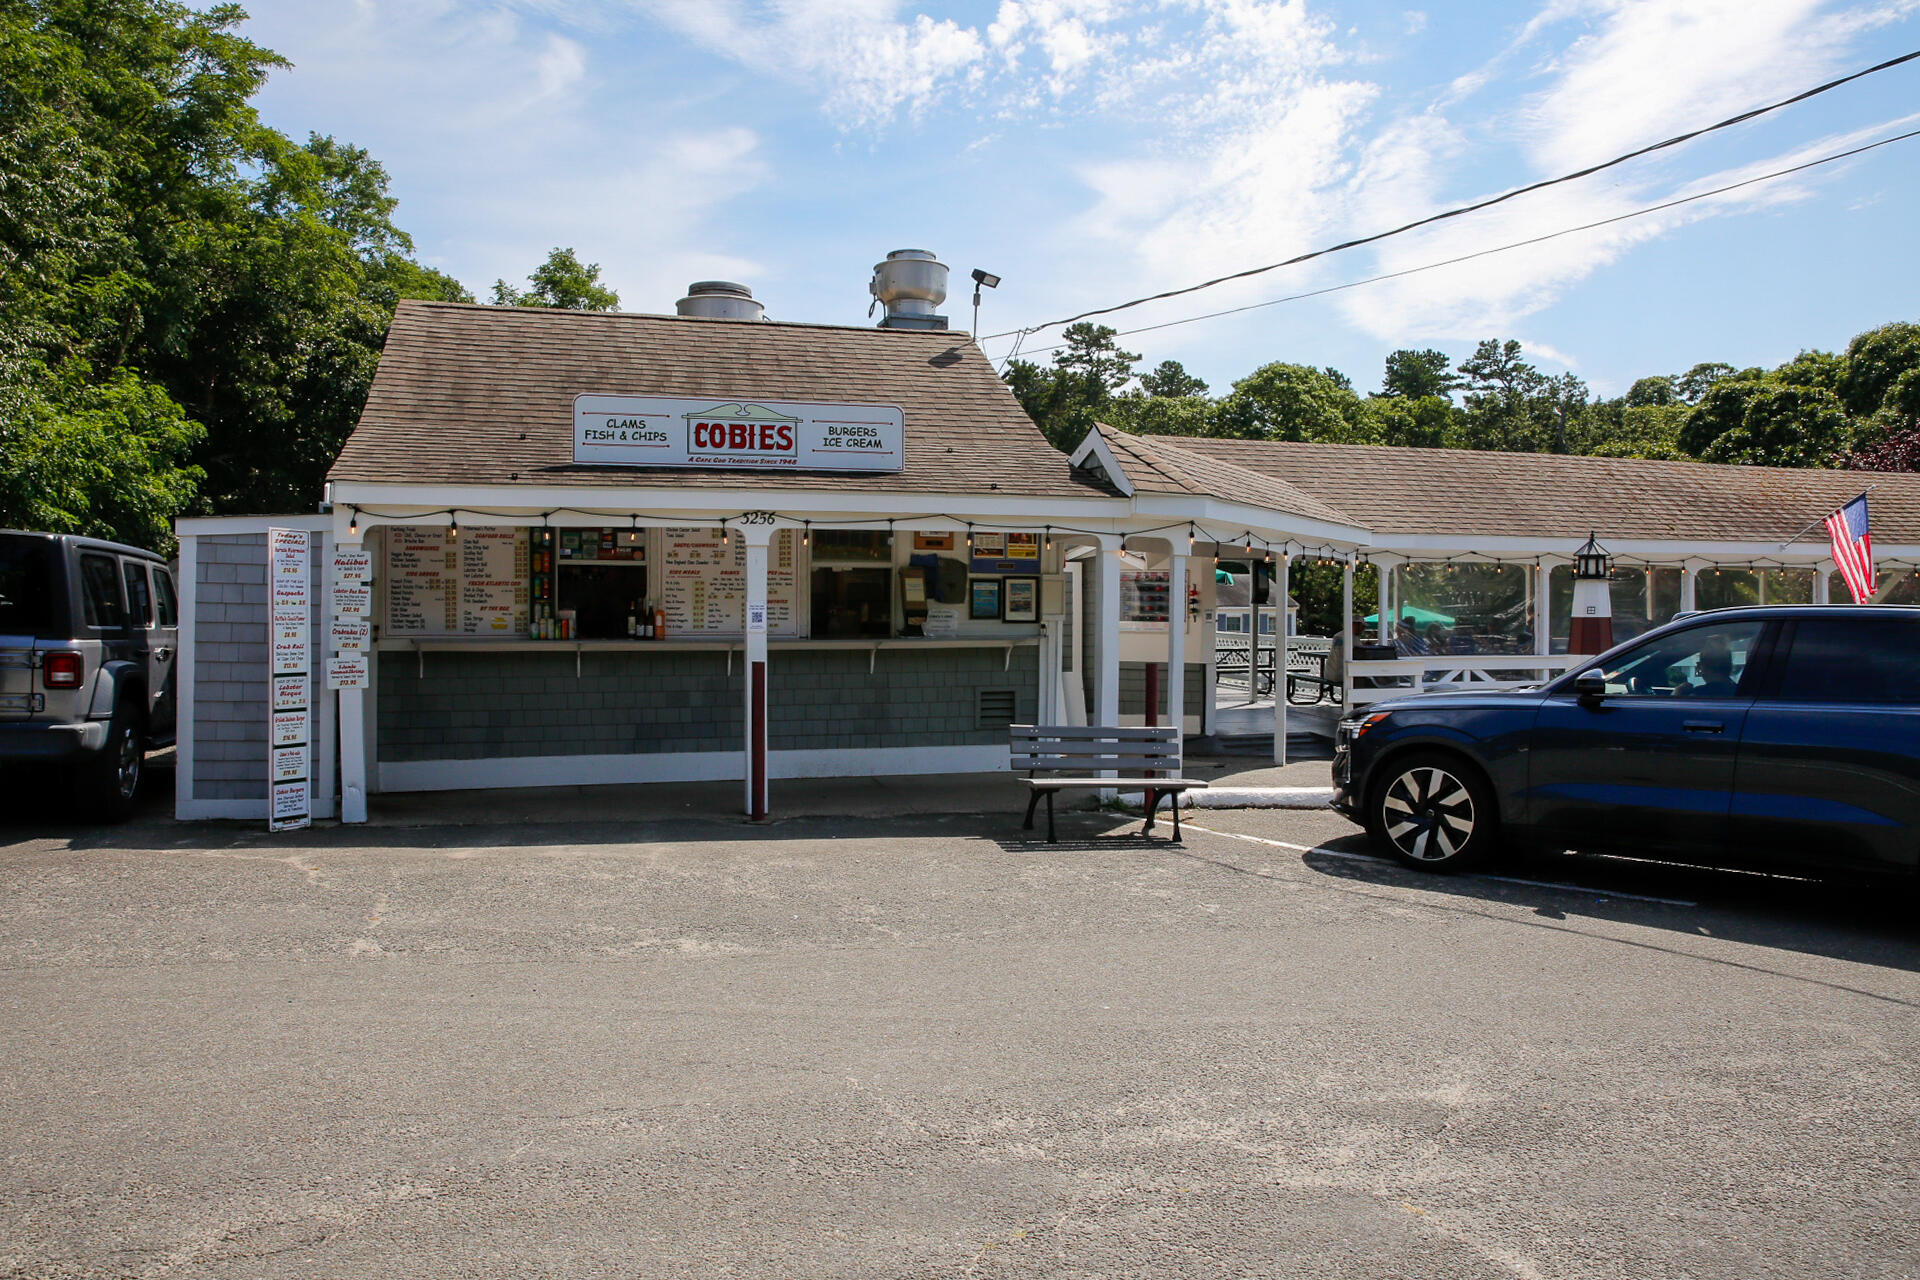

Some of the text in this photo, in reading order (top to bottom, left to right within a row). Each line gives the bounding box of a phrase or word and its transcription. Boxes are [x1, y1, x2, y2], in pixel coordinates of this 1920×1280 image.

[606, 419, 646, 430] CLAMS
[584, 430, 667, 442] FISH & CHIPS
[694, 423, 793, 450] COBIES
[828, 426, 878, 437] BURGERS
[823, 438, 883, 449] ICE CREAM
[740, 511, 776, 526] 5256
